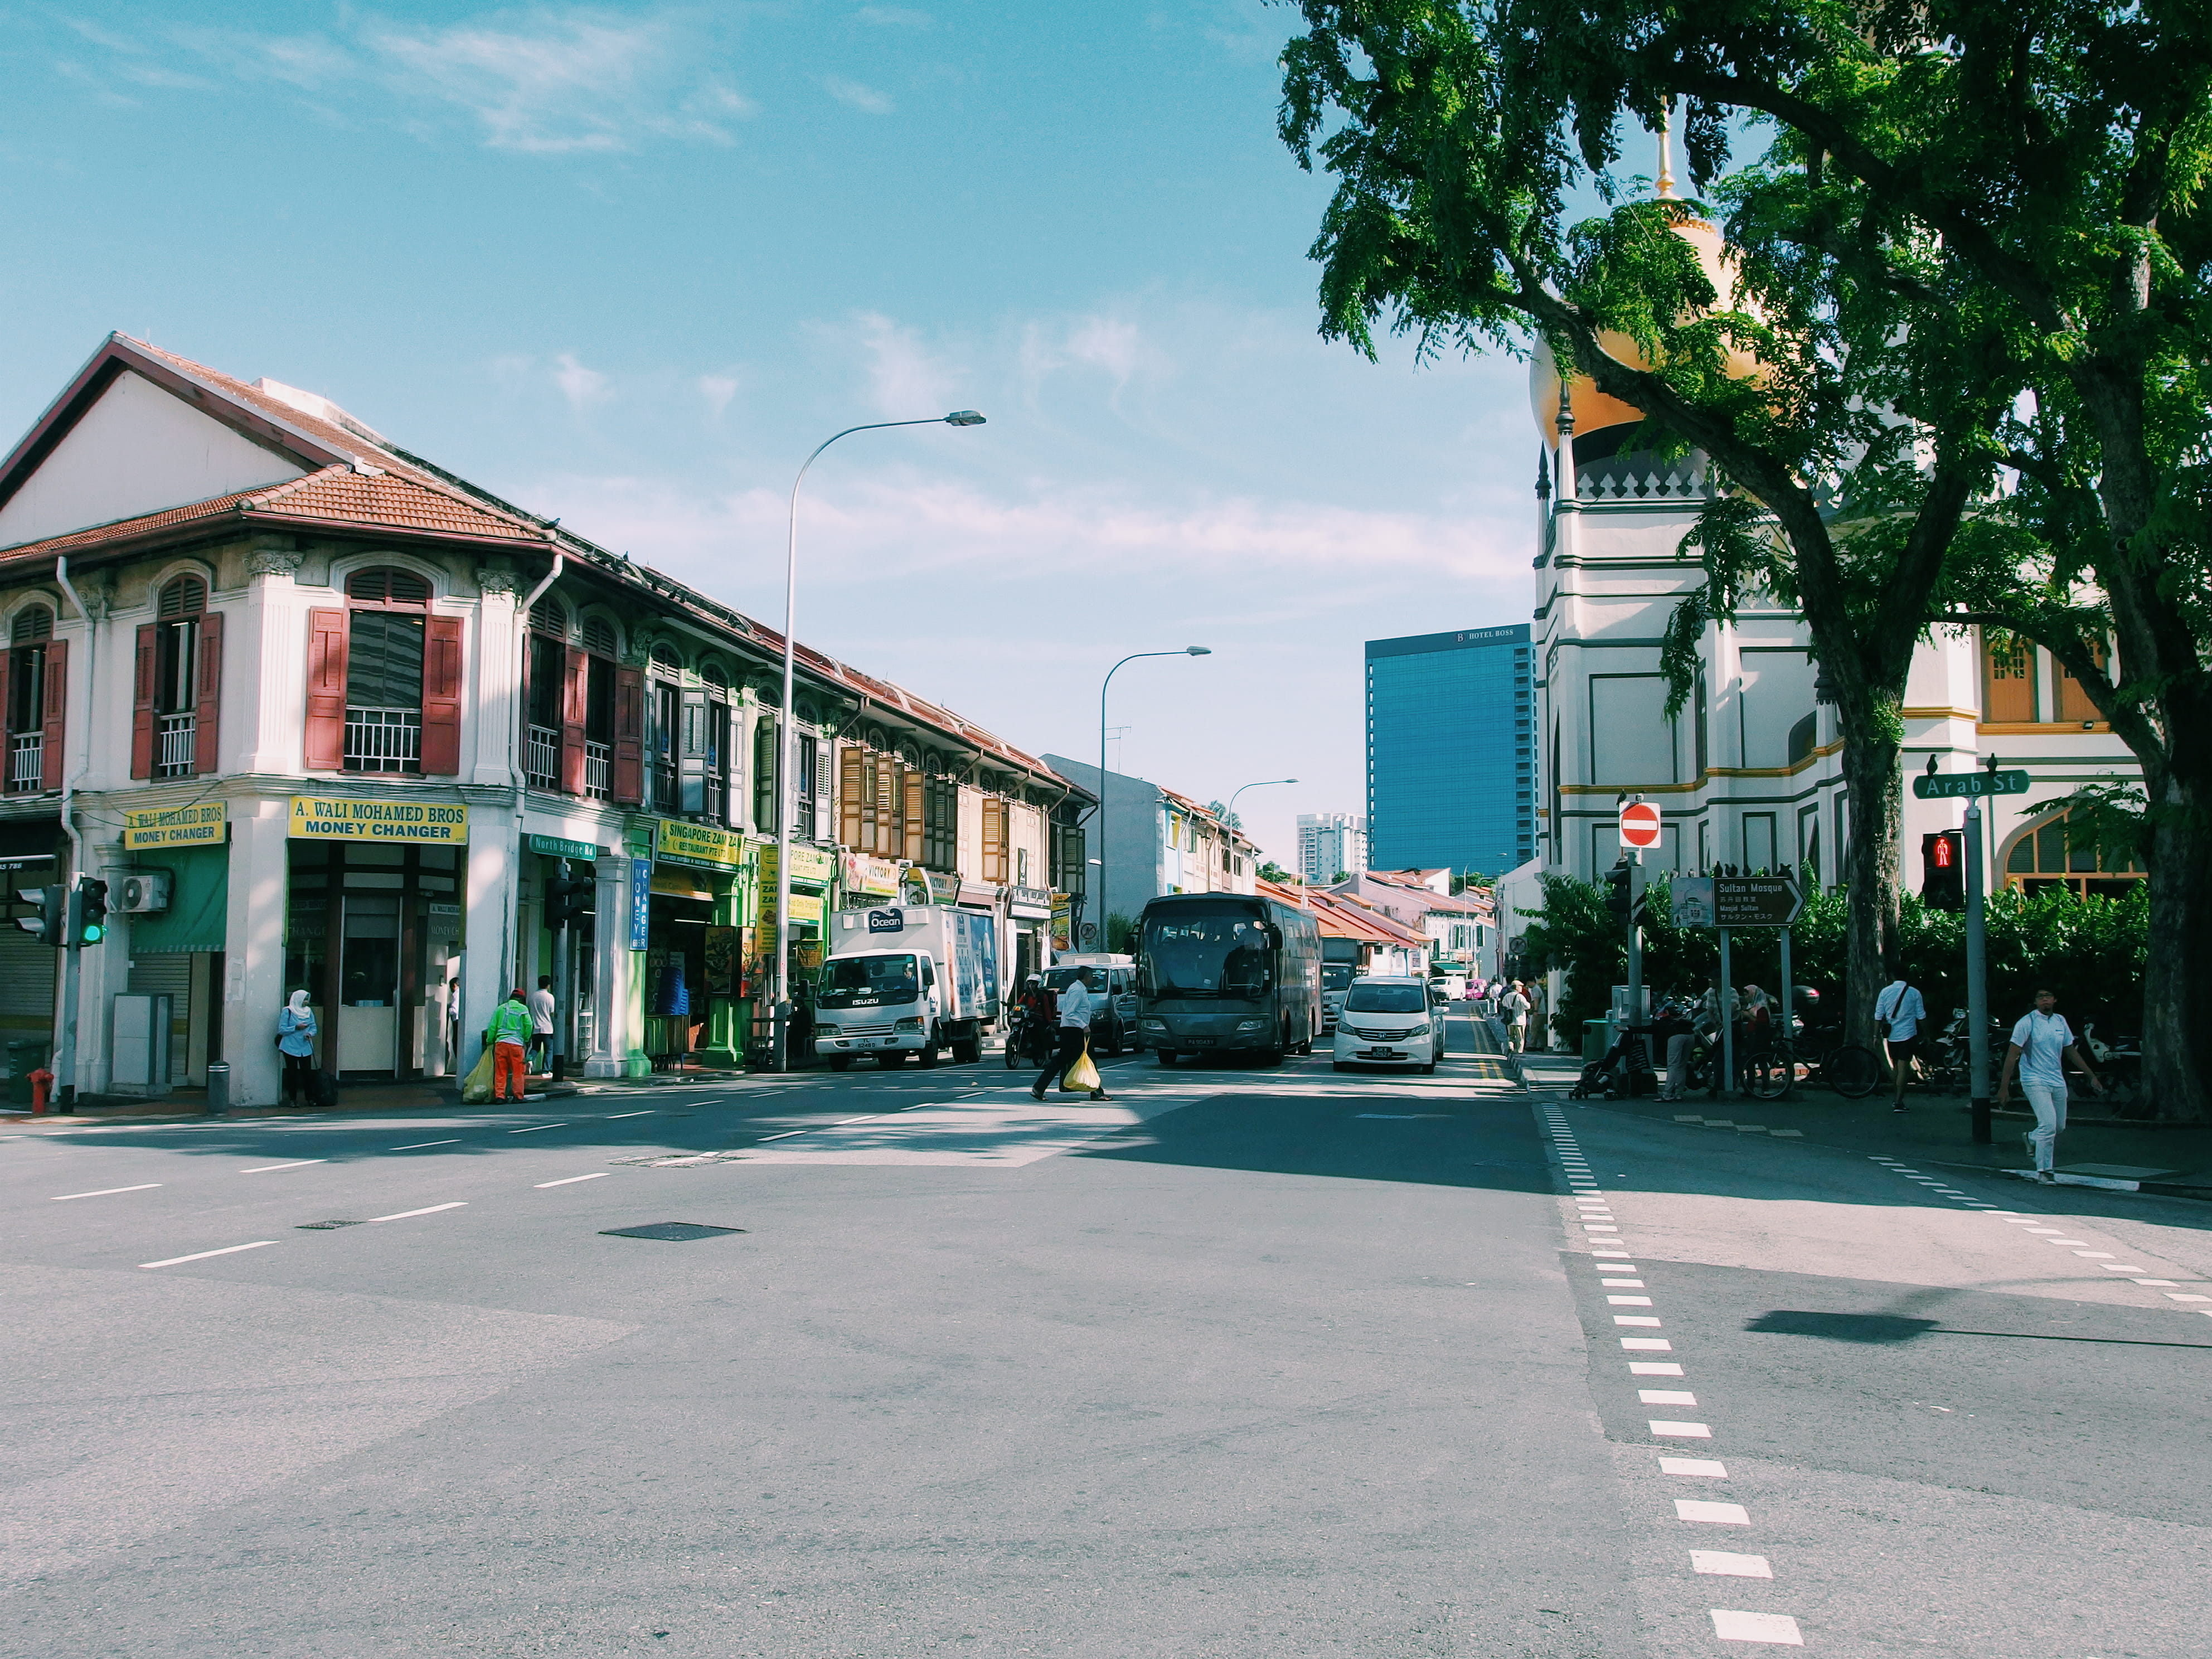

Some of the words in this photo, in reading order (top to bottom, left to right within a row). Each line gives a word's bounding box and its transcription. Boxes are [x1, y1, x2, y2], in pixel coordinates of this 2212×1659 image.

[1469, 631, 1493, 639] HOTEL
[1926, 775, 1981, 795] Arab
[1993, 774, 2016, 792] St
[138, 813, 157, 828] WALI
[159, 809, 198, 827] MOHAMED
[201, 807, 222, 823] BROS
[295, 802, 308, 816] A.
[314, 802, 348, 818] WALI
[352, 803, 424, 822] MOHAMED
[428, 807, 464, 824] BROS
[134, 830, 167, 843] MONEY
[169, 826, 215, 841] CHANGER
[306, 821, 366, 835] MONEY
[372, 823, 451, 838] CHANGER
[670, 823, 711, 843] SINGAPORE
[536, 836, 557, 851] North
[560, 841, 583, 856] Bridge
[585, 845, 593, 856] Rd
[678, 841, 708, 855] RESTAURANT
[709, 847, 717, 857] PTE
[869, 865, 891, 879] VICTORY
[1719, 884, 1746, 892] Sultan
[1750, 883, 1783, 894] Mosque
[871, 918, 901, 927] Ocean
